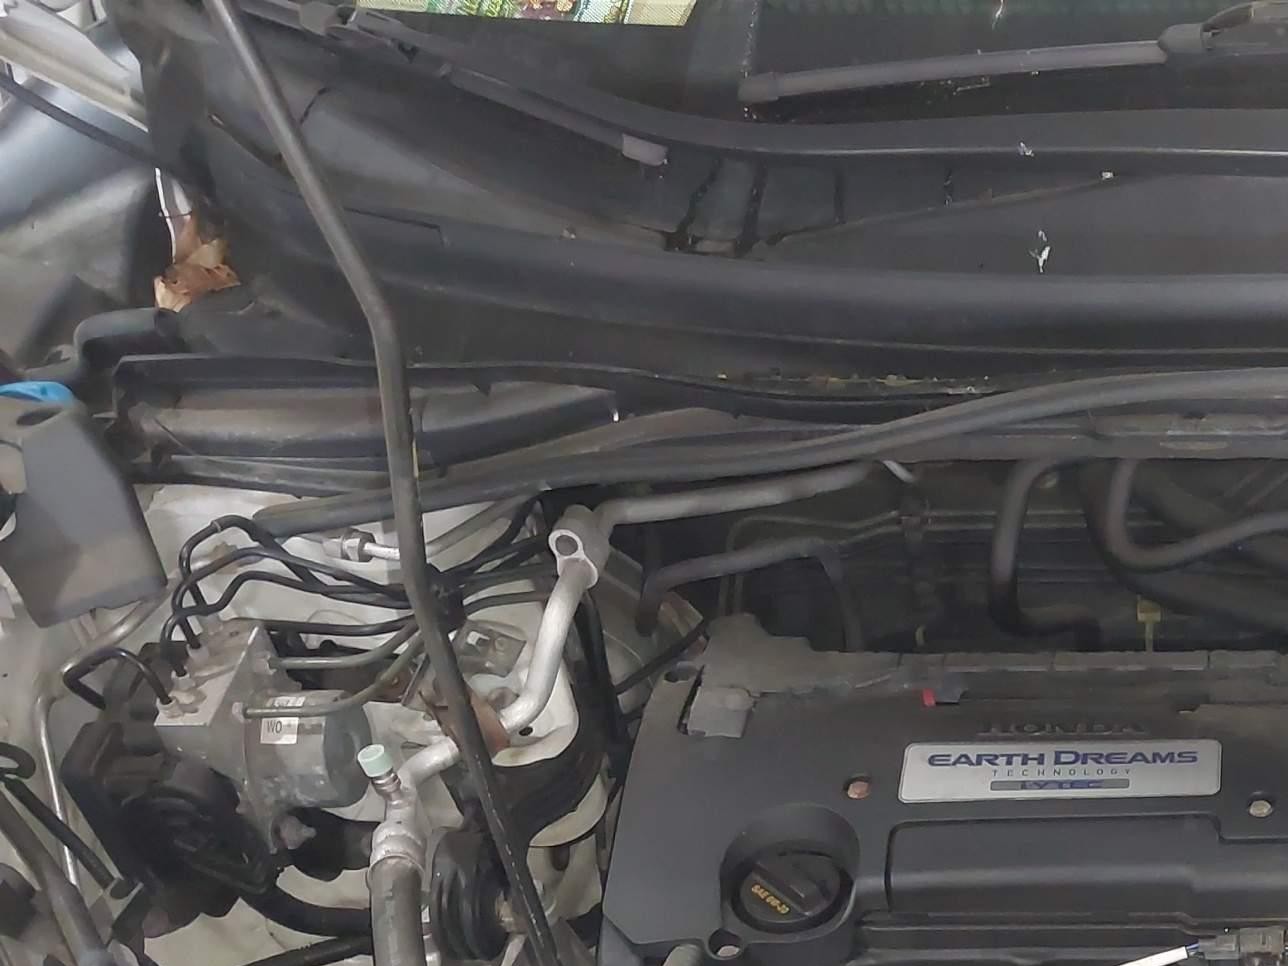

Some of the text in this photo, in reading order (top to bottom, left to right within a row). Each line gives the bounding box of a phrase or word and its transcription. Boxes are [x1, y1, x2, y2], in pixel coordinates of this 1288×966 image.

[928, 750, 1199, 767] EARTH DREAMS
[992, 768, 1131, 777] TECHNOLOGY
